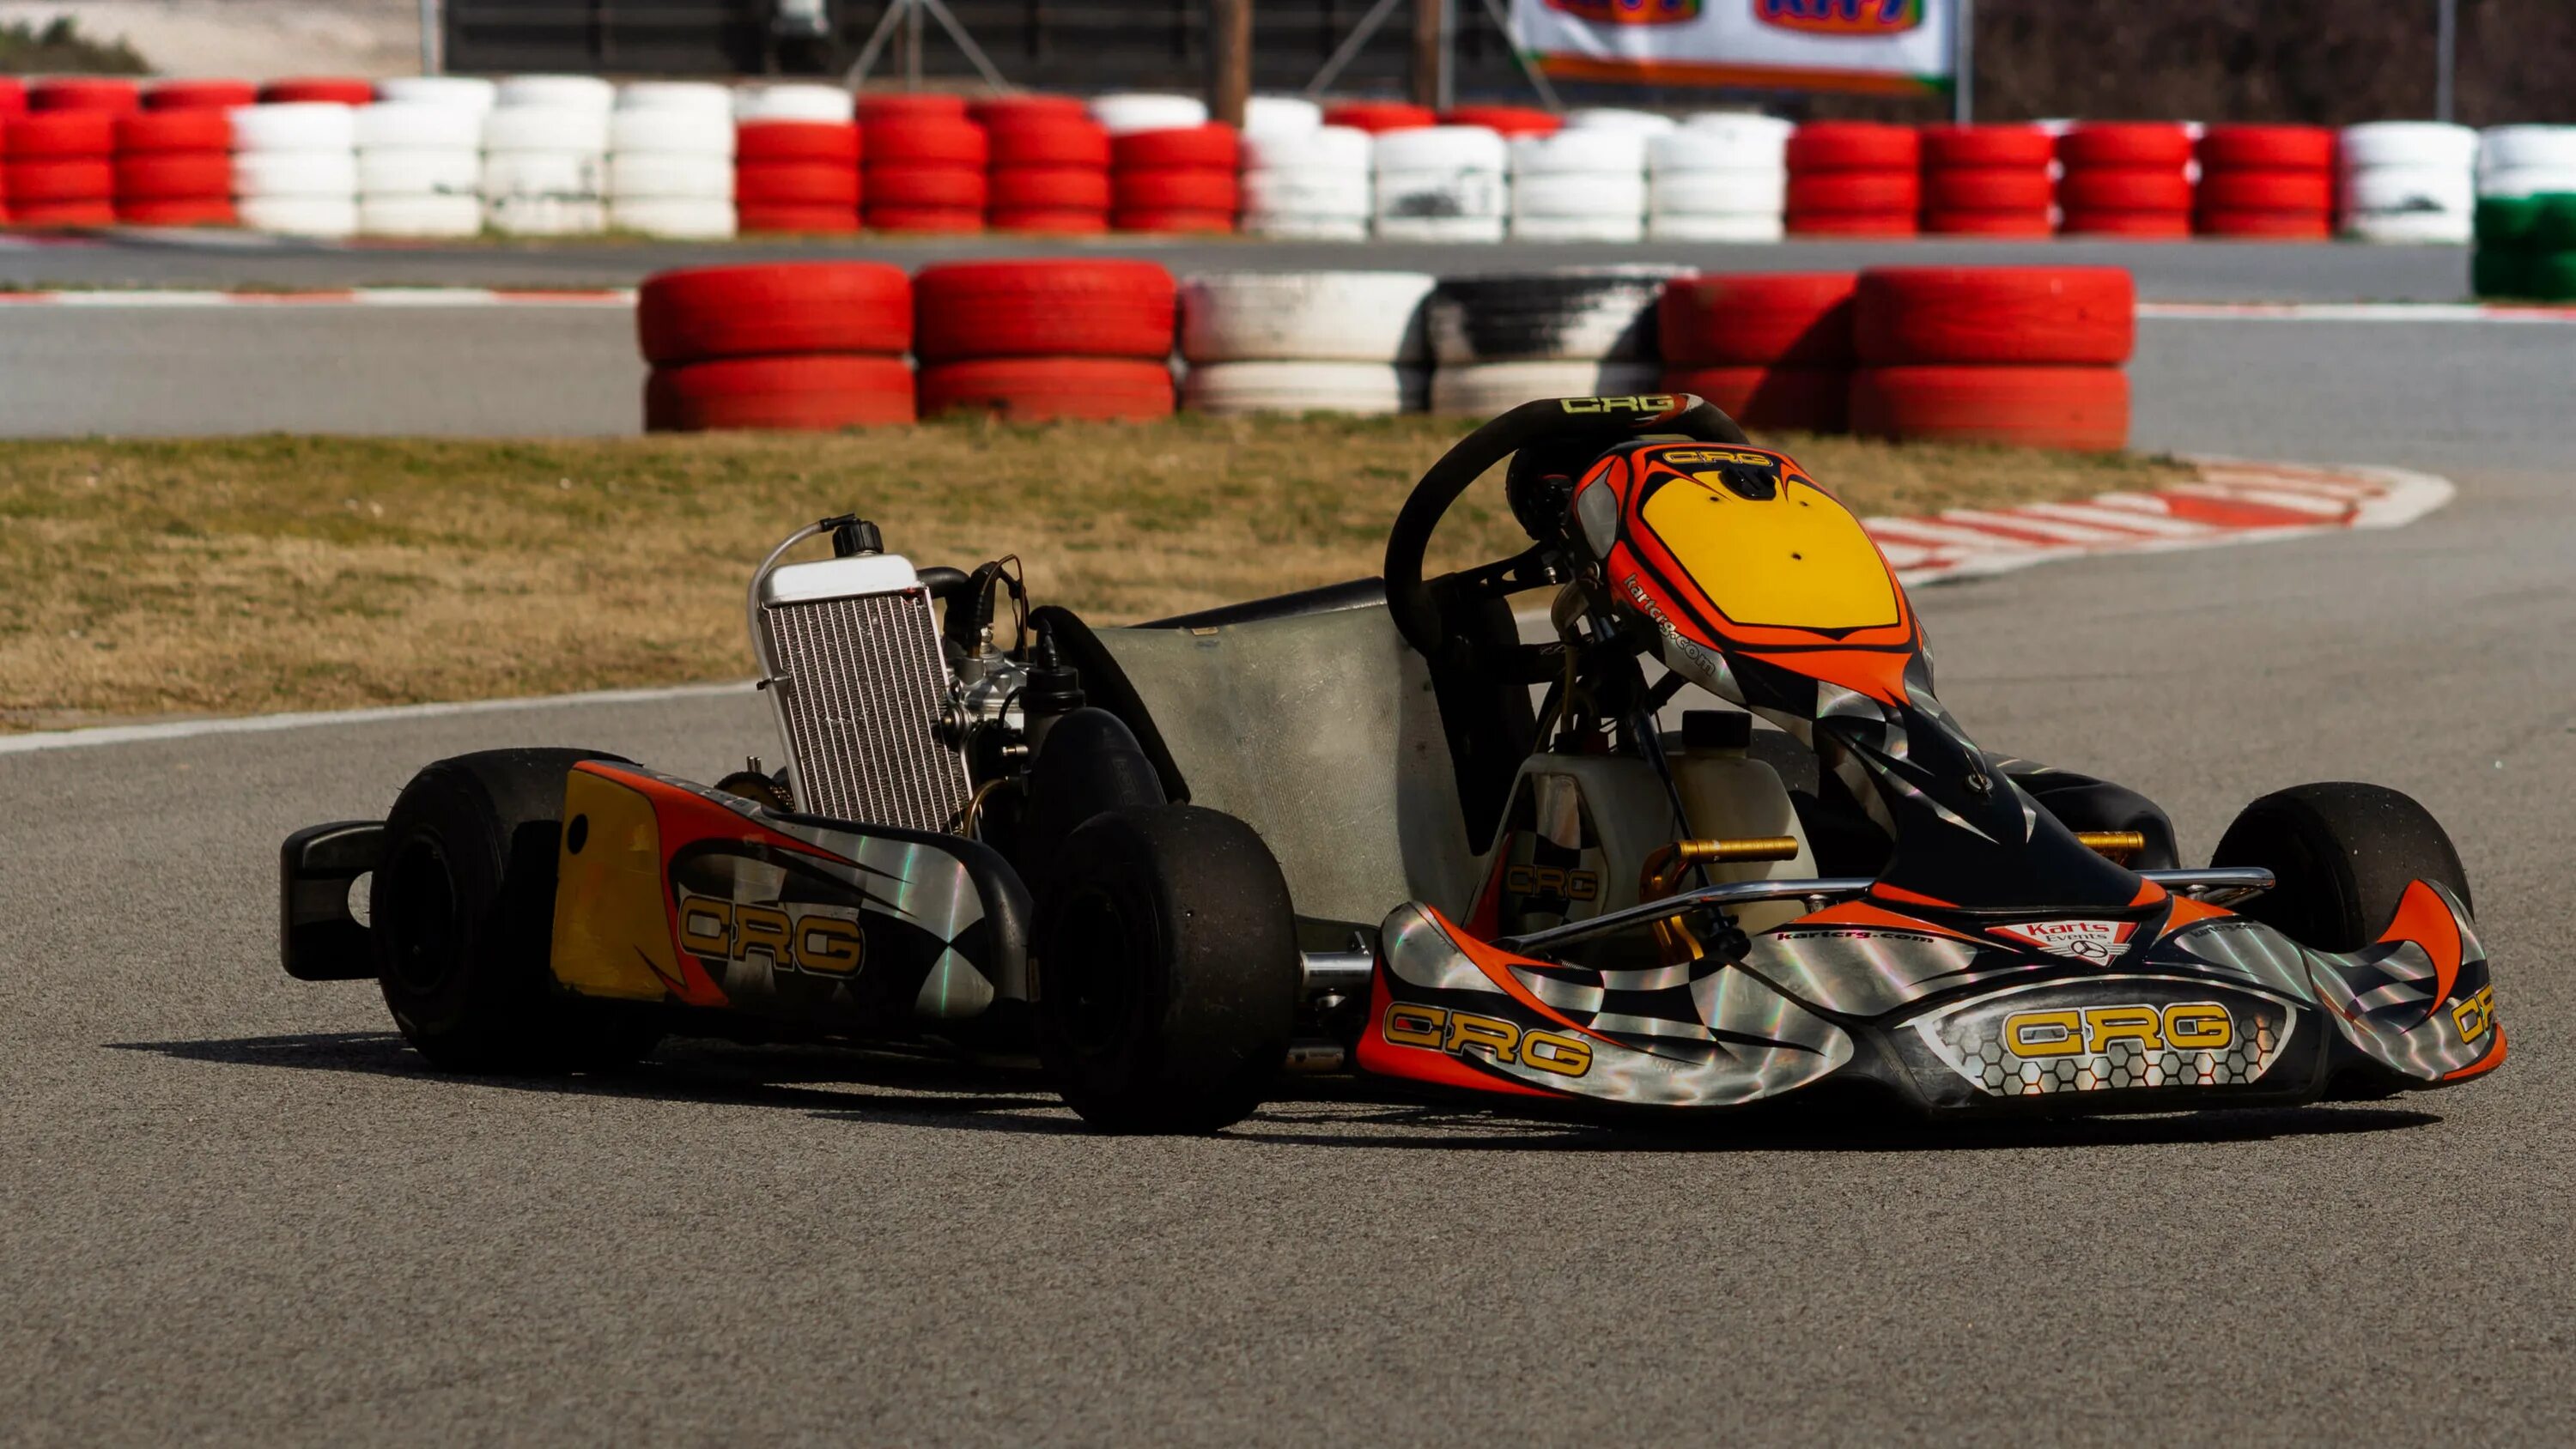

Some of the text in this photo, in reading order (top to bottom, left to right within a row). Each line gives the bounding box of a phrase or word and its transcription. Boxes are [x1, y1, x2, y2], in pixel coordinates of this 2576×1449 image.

[1562, 397, 1675, 413] CRG
[1662, 451, 1773, 467] CRG
[1625, 574, 1716, 677] kartcrg.com
[1507, 864, 1598, 900] CRG
[679, 895, 864, 979] CRG
[1777, 931, 1934, 943] kartcrg.com
[2026, 922, 2110, 936] Karts
[2046, 933, 2107, 942] Events
[1383, 1002, 1595, 1078] CRG
[2003, 1002, 2234, 1058] CRG
